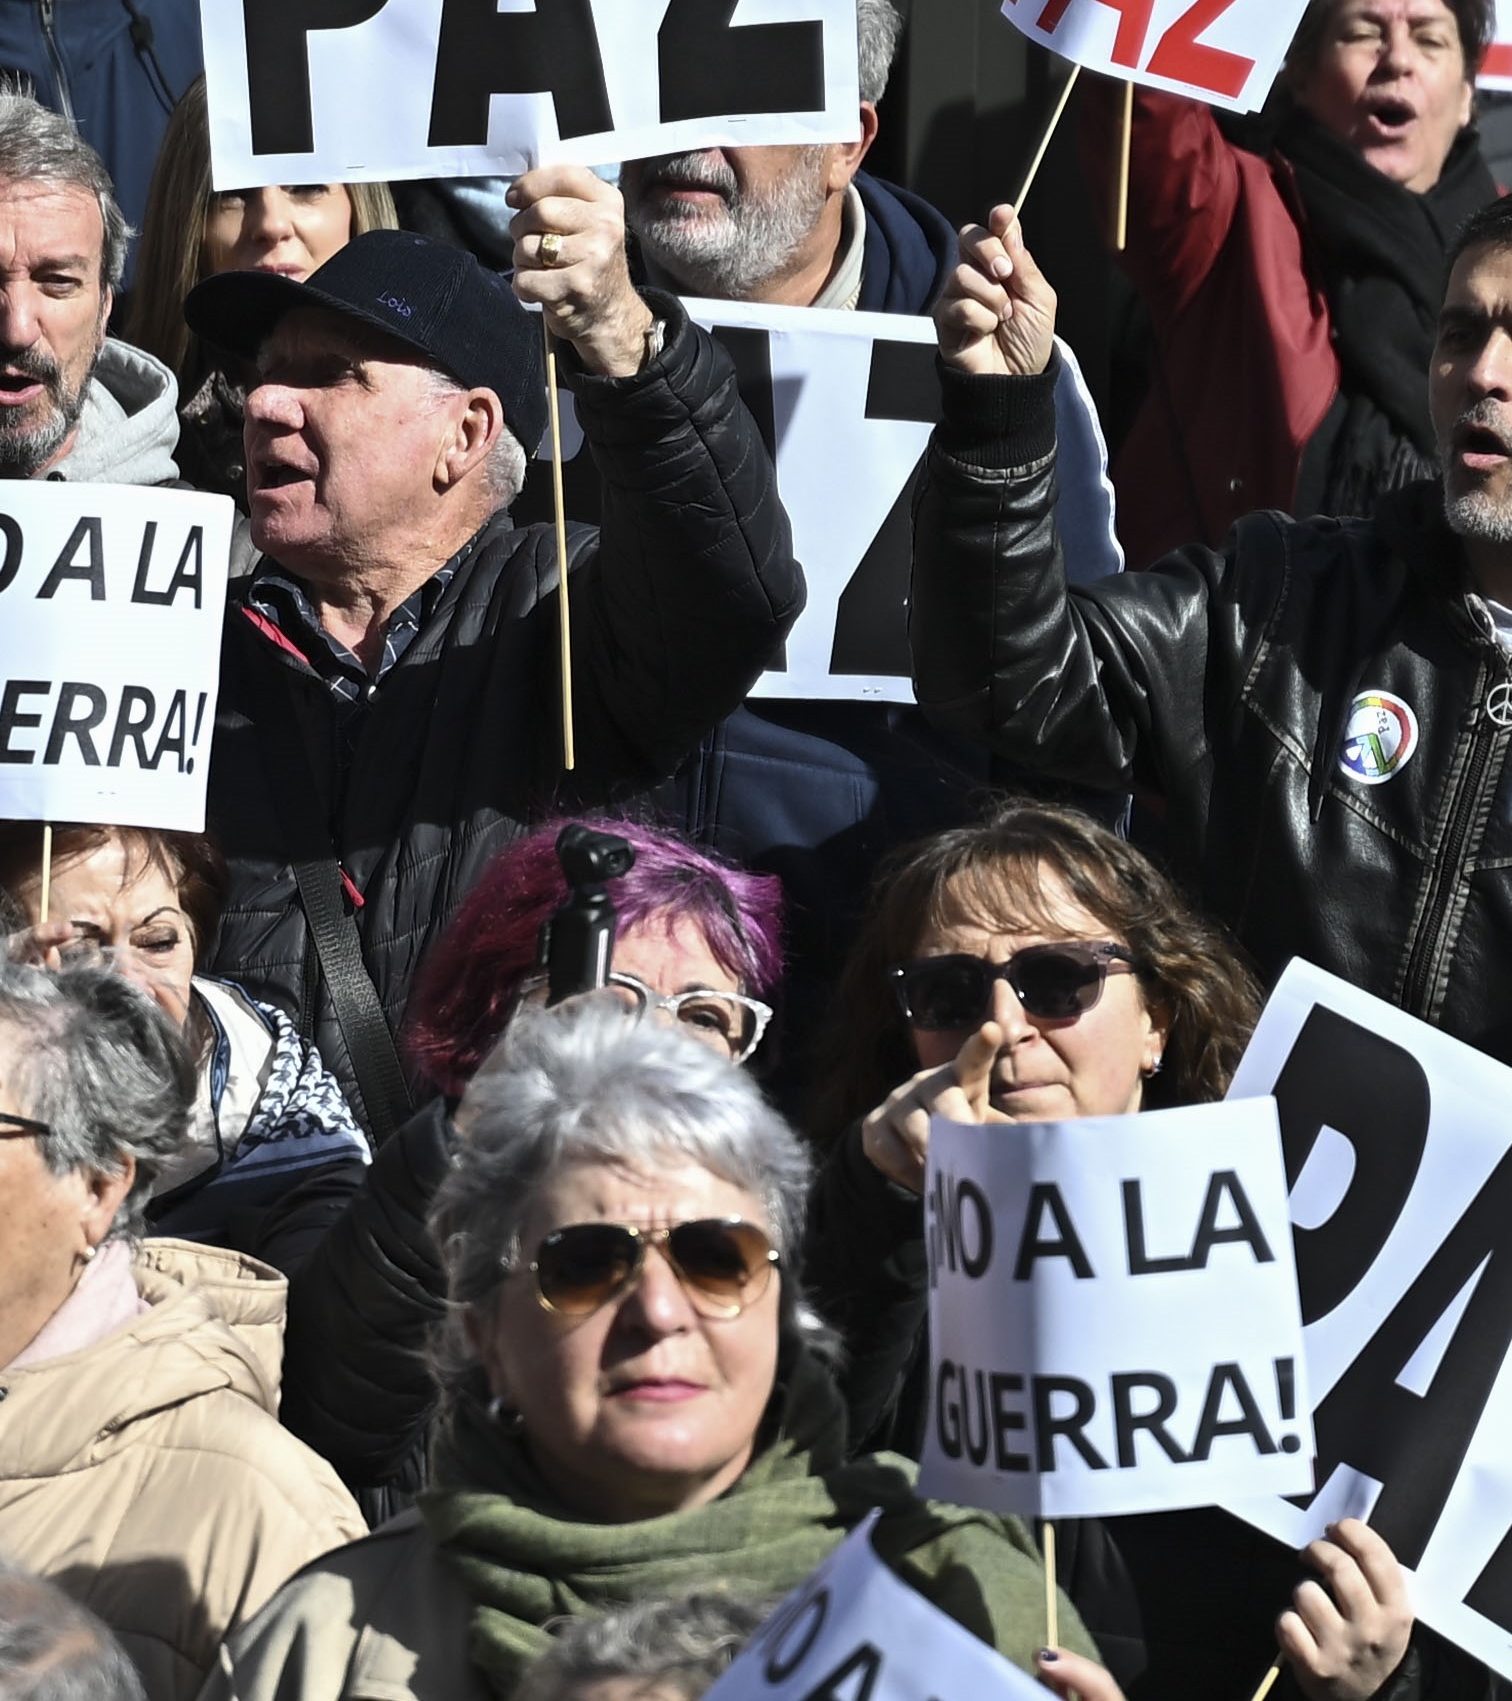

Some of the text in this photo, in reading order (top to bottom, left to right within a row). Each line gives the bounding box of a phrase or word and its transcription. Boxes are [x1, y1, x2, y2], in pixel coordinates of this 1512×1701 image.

[37, 517, 107, 602] A
[130, 521, 203, 611] LA
[1014, 1182, 1096, 1282] A
[1122, 1169, 1276, 1277] LA
[935, 1355, 1304, 1473] GUERRA!
